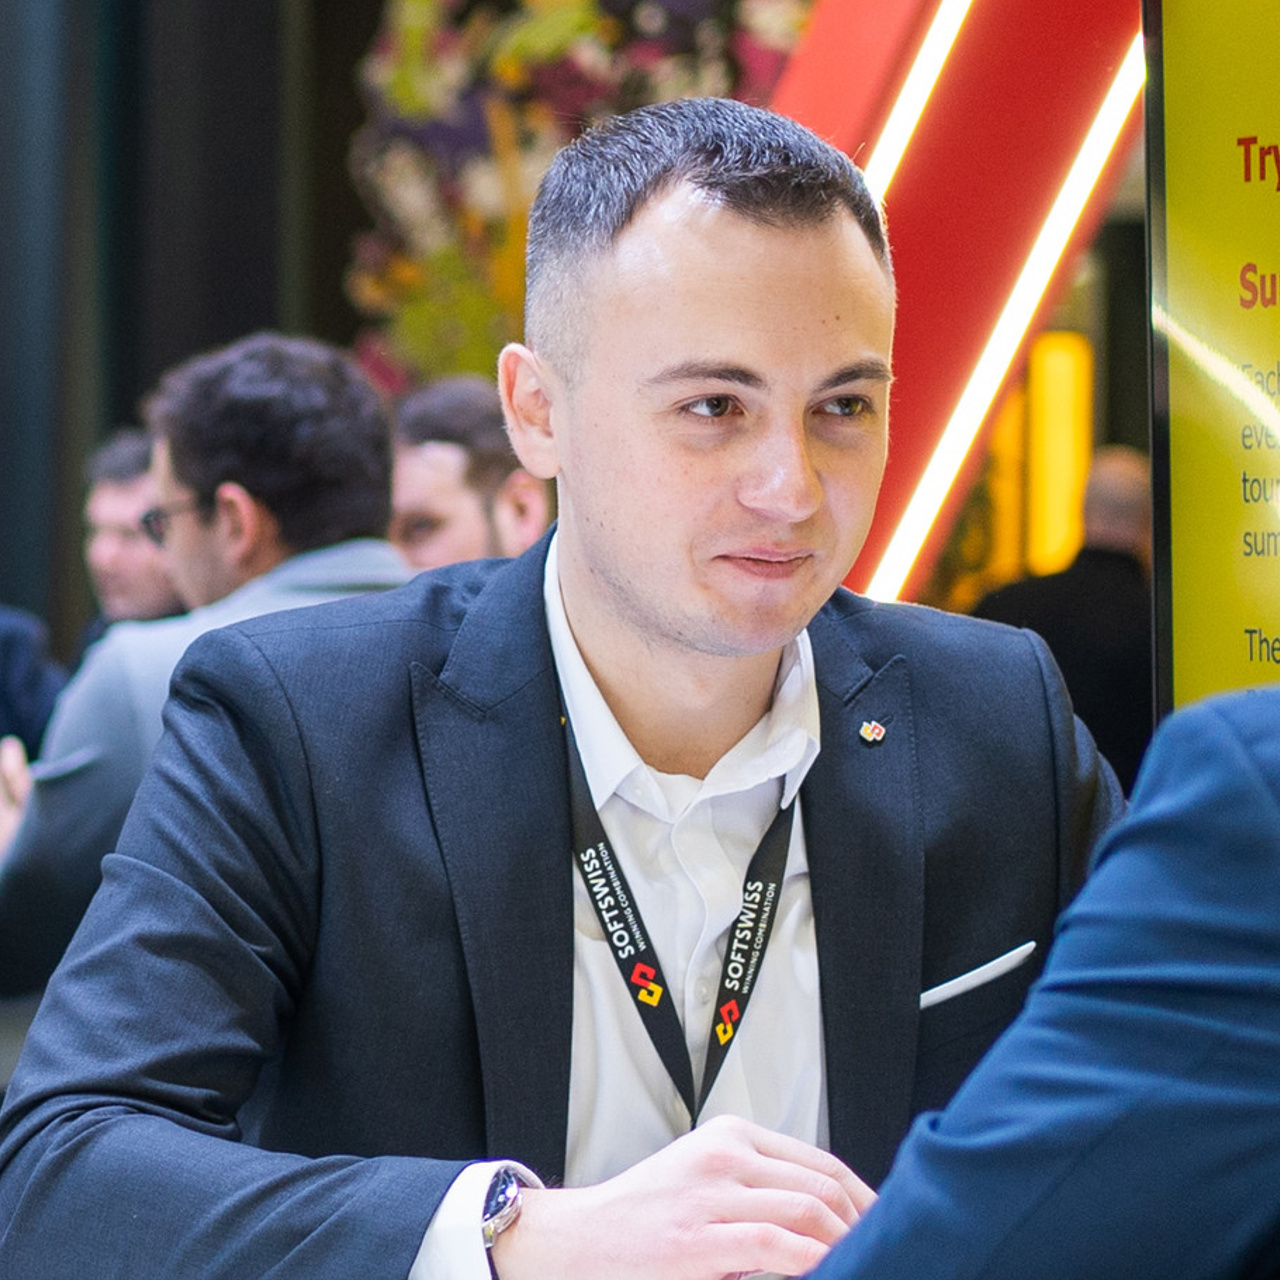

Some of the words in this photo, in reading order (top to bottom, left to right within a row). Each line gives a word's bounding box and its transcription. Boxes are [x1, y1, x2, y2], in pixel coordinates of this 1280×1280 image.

[1239, 262, 1280, 309] Su
[1241, 424, 1280, 451] eve
[1241, 470, 1280, 504] tou
[1244, 627, 1280, 664] The
[598, 842, 629, 908] COMBINATION
[580, 848, 635, 959] SOFTSWISS
[624, 907, 647, 952] WINNING
[725, 881, 764, 991] SOFTSWISS
[742, 950, 760, 994] WINNING
[753, 883, 777, 950] COMBINATION
